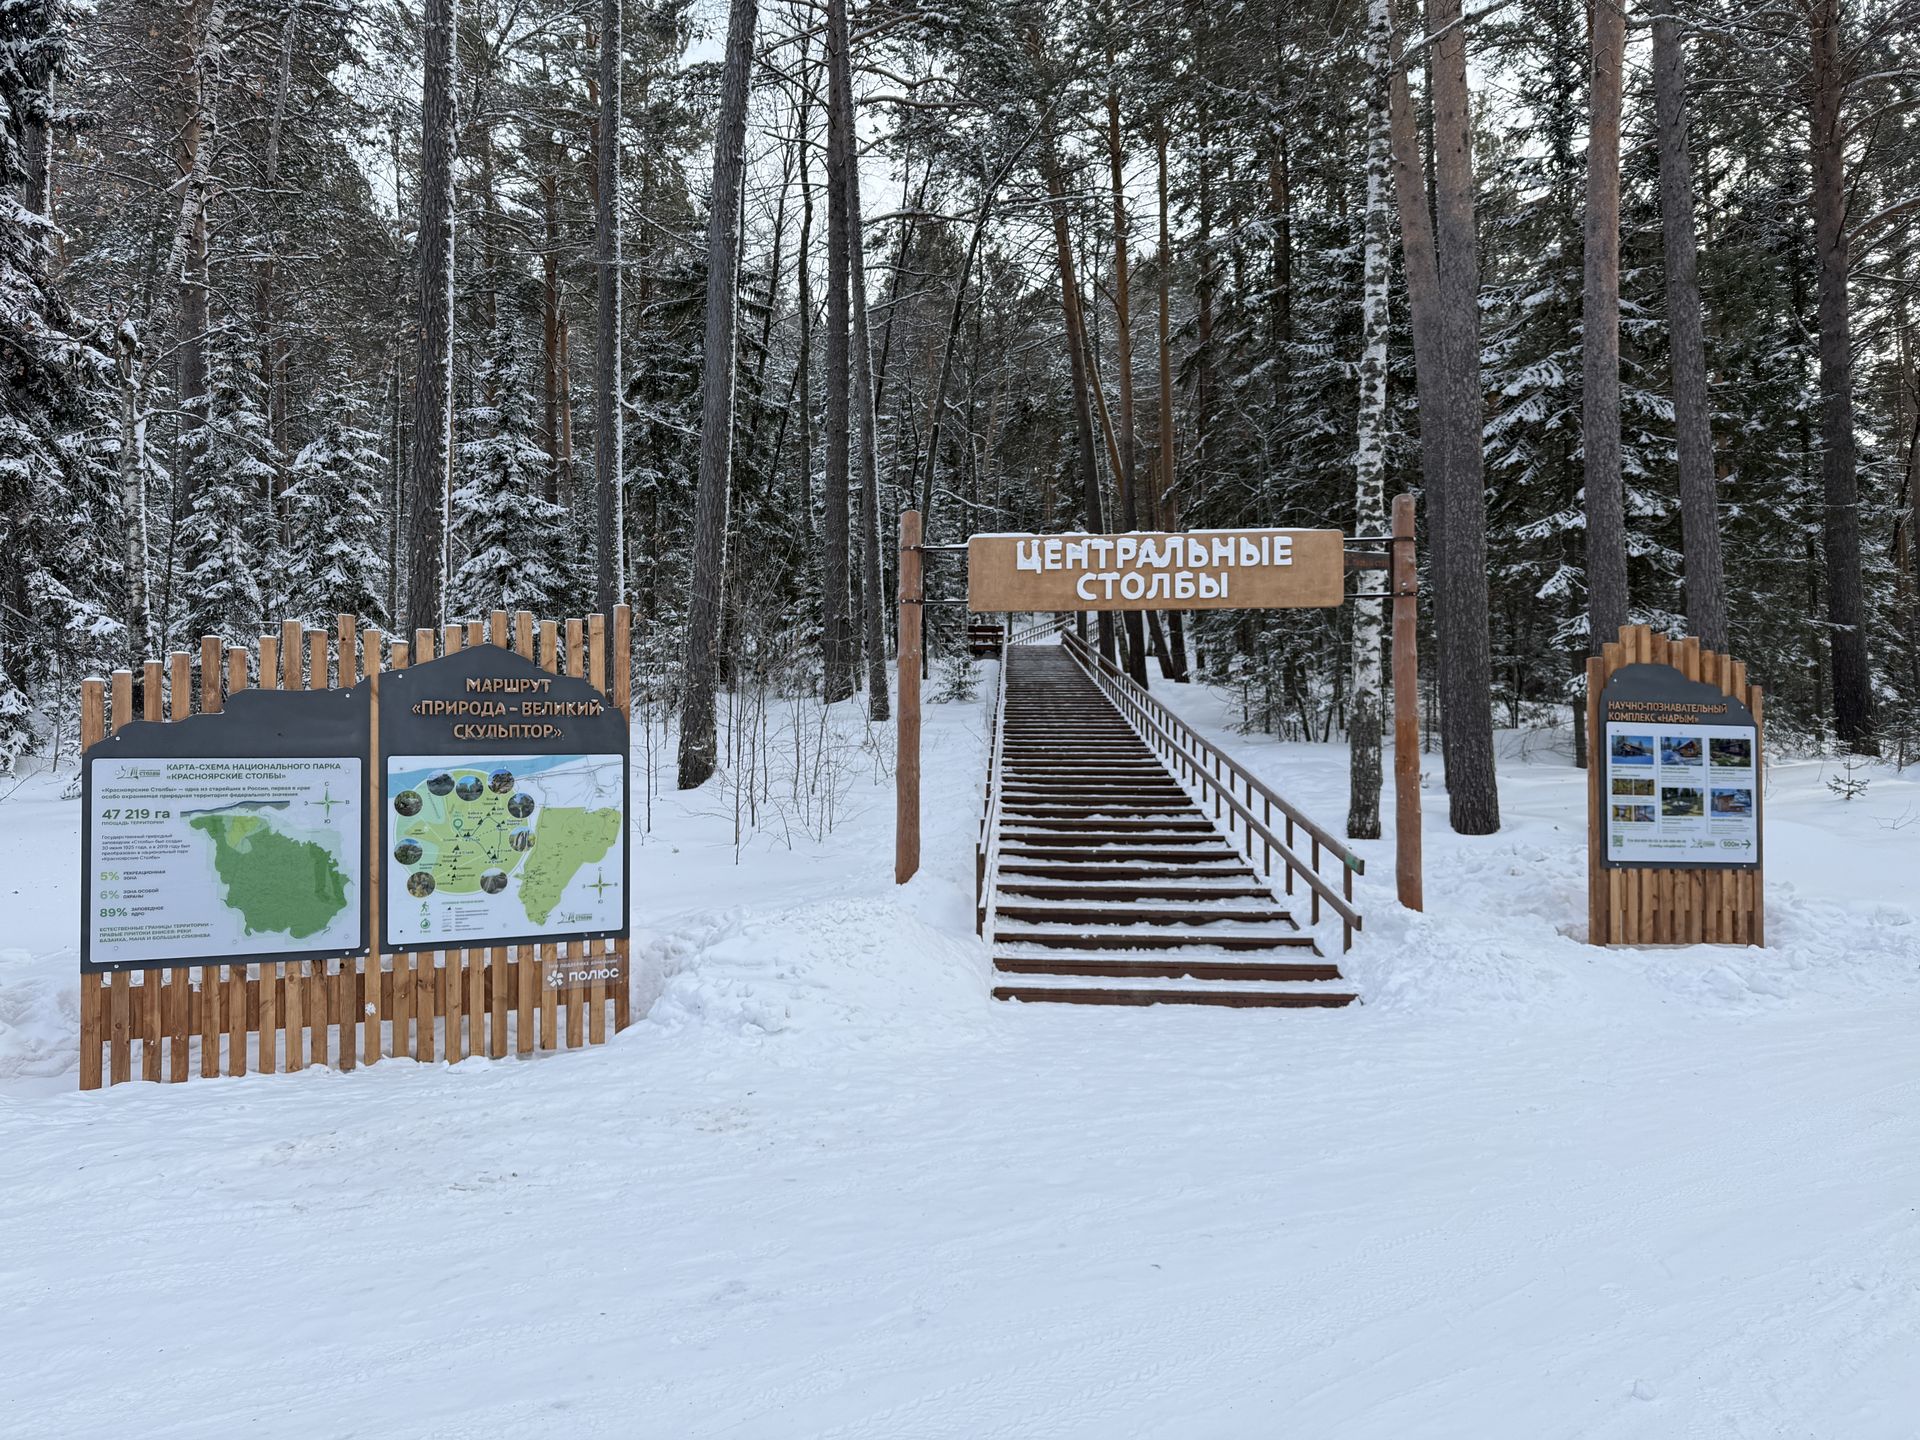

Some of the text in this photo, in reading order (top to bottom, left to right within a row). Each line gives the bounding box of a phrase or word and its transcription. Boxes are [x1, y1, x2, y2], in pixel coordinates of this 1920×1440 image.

[1016, 536, 1292, 574] ЦЕНТРАЛЬНЫЕ
[1076, 571, 1228, 600] СТОЛБЫ
[466, 678, 552, 694] МАРШРУТ
[412, 700, 506, 717] «ПРИРОДА
[522, 699, 600, 716] ВЕЛИКИЙ
[1608, 701, 1728, 713] НАУЧНО-ПОЗНАВАТЕЛЬНЫЙ
[1608, 712, 1699, 723] КОМПЛЕКС «НАРЫМ»
[454, 724, 562, 739] СКУЛЬПТОР»
[102, 809, 120, 819] 47
[125, 809, 150, 819] 219
[100, 872, 119, 880] 5%
[100, 890, 119, 899] 6%
[100, 908, 127, 917] 89%
[569, 968, 619, 982] ПОЛЮС
